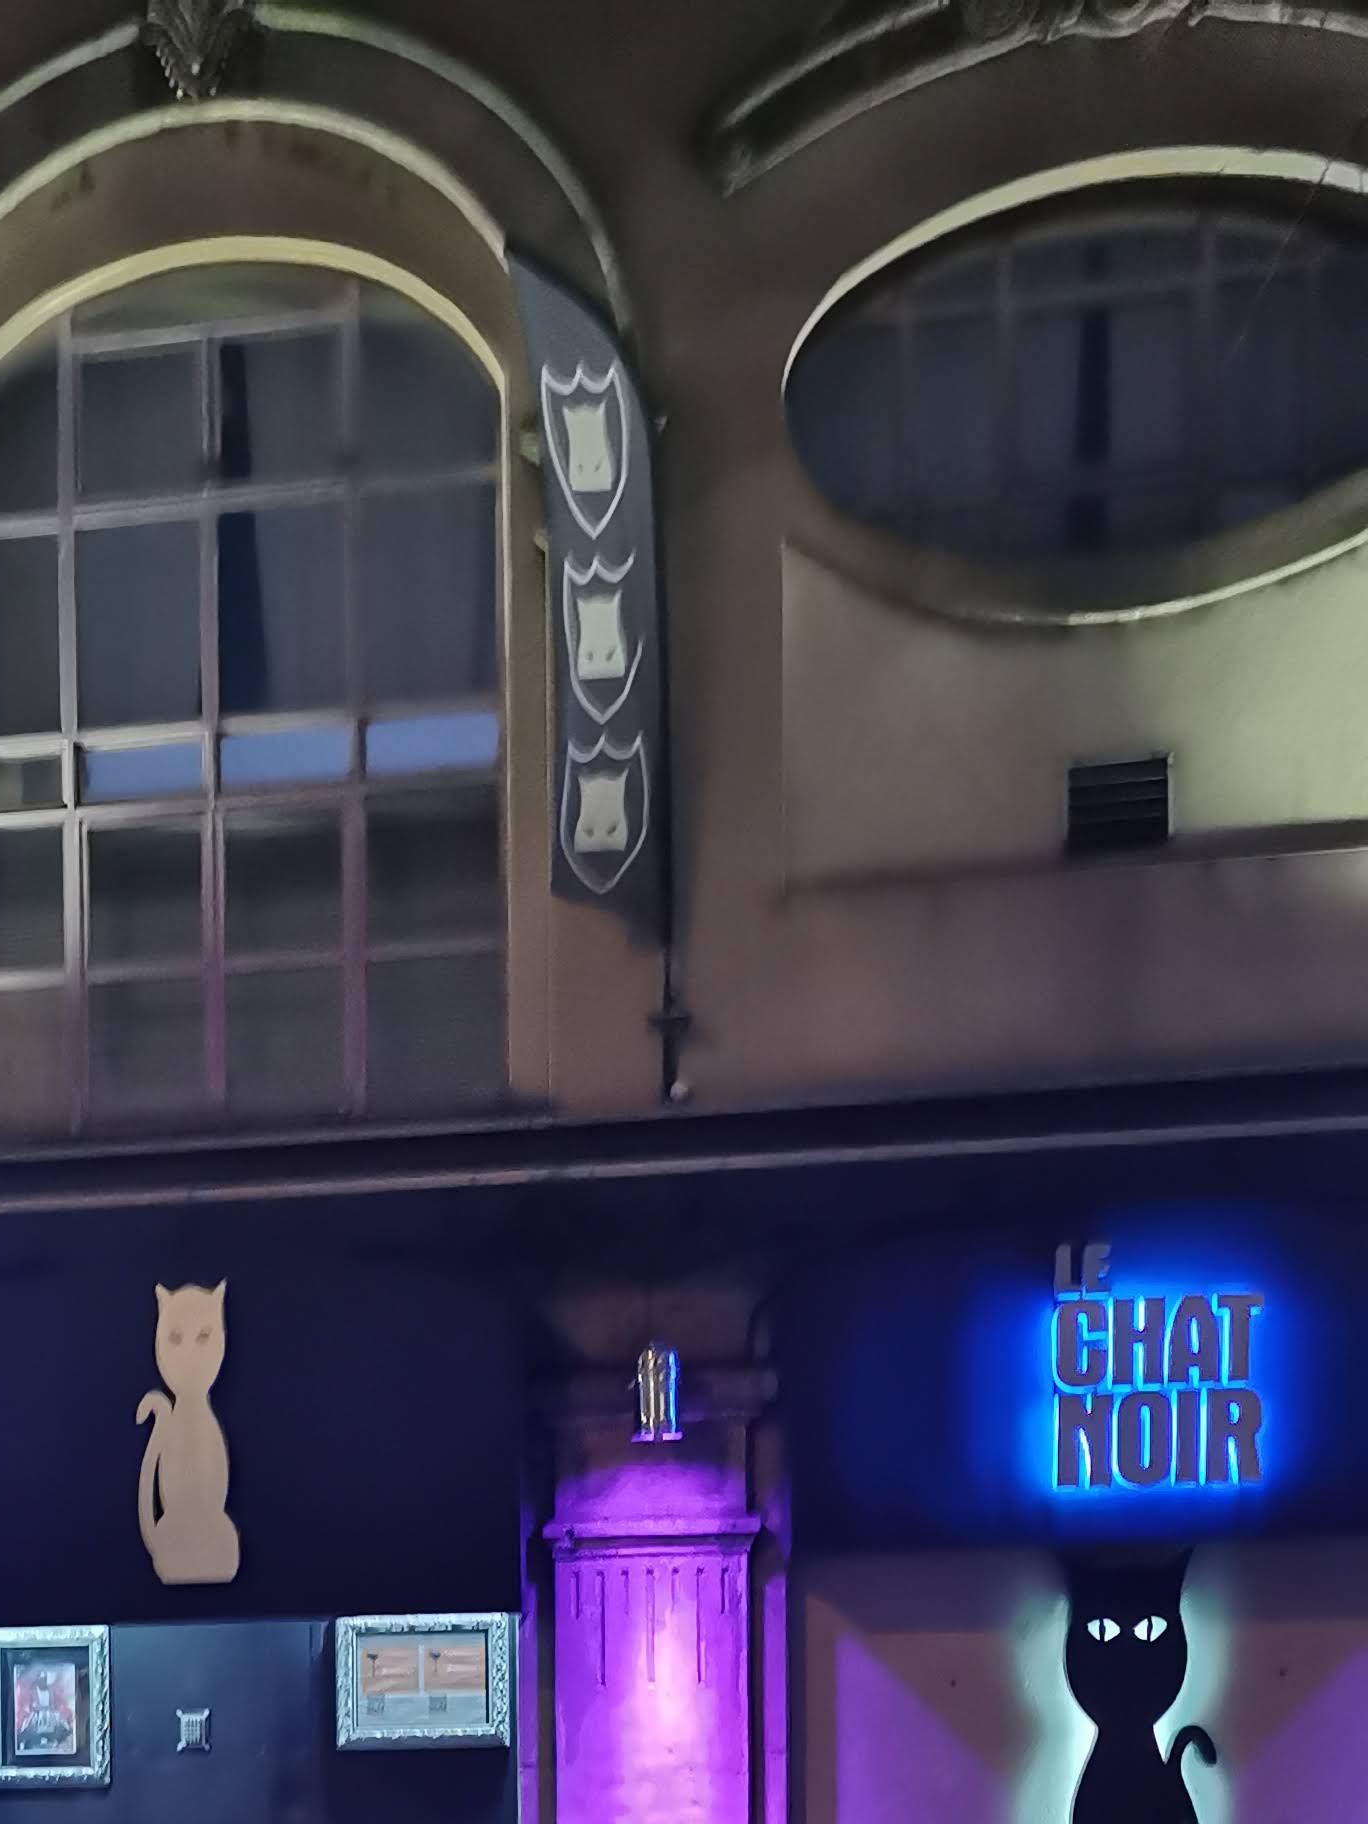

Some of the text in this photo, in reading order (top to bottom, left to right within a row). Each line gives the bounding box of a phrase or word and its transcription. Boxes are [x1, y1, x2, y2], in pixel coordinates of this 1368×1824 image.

[1053, 1243, 1112, 1293] LE
[1054, 1293, 1264, 1389] CHAT
[1055, 1388, 1263, 1487] NOIR
